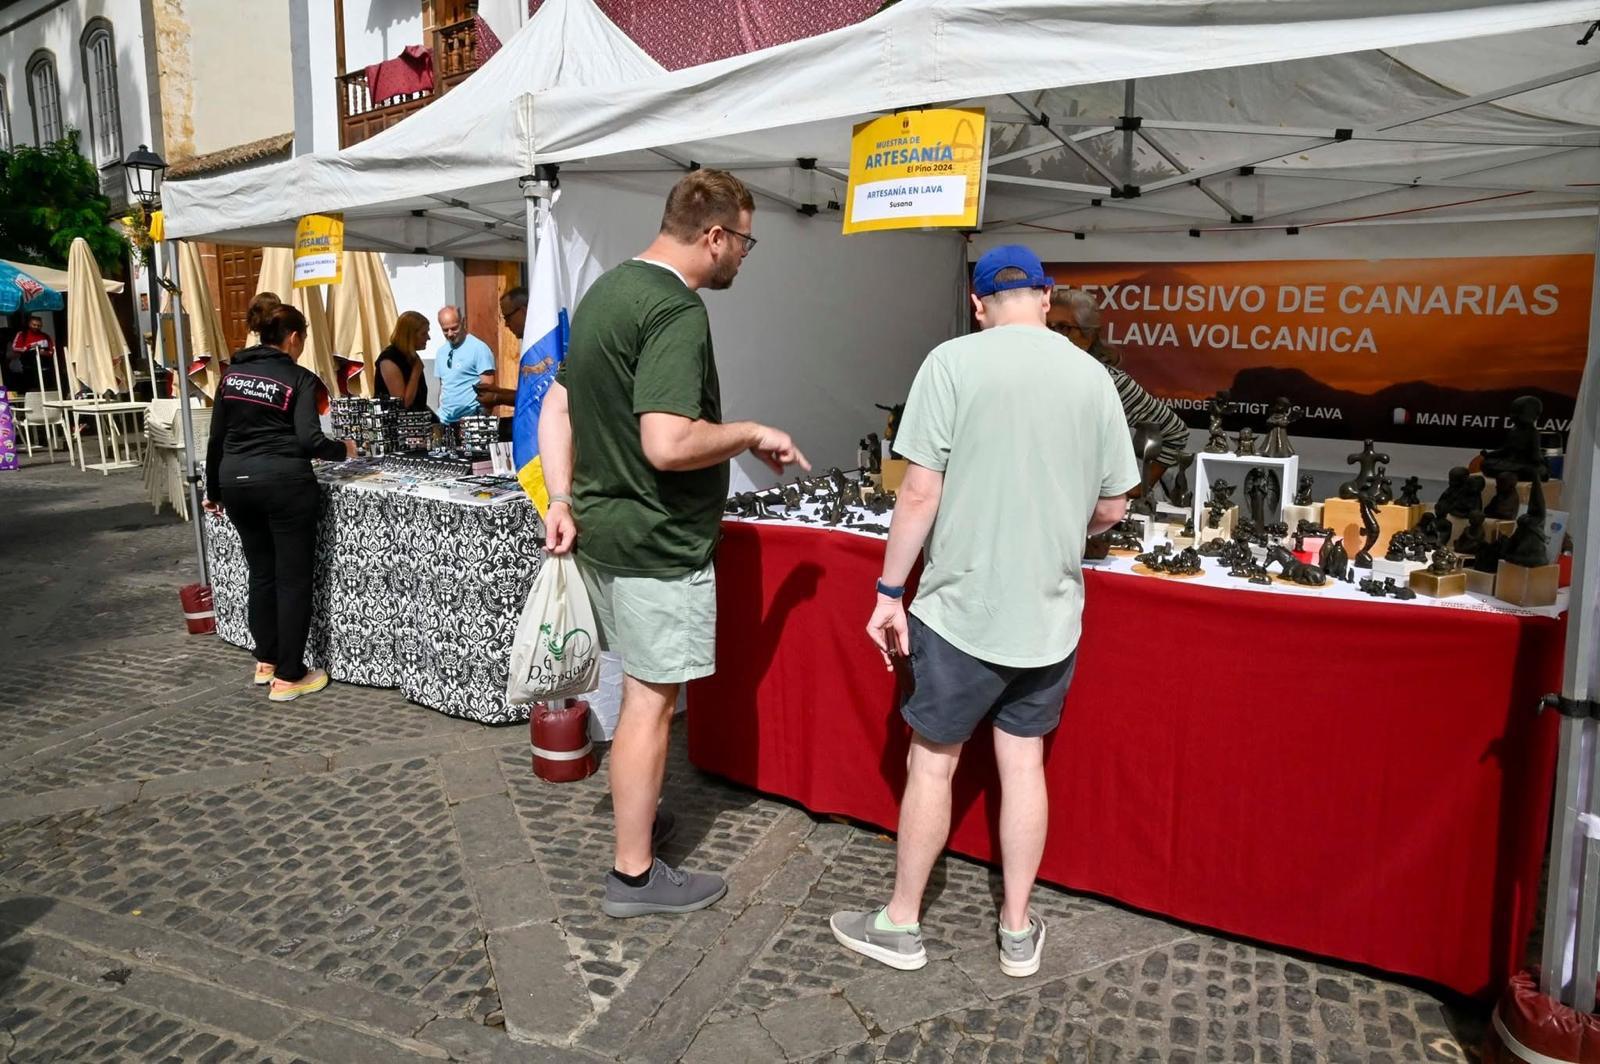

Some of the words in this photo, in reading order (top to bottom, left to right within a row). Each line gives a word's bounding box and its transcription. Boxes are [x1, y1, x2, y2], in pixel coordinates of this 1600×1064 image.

[876, 138, 908, 149] MUESTRA
[910, 136, 921, 144] DE
[865, 142, 953, 169] ARTESANÍA
[915, 165, 932, 173] Pino
[933, 164, 953, 172] 2024
[867, 185, 907, 200] ARTESANÍA
[908, 186, 919, 195] EN
[921, 185, 943, 195] LAVA
[1277, 285, 1327, 314] DE
[1338, 284, 1560, 316] CANARIAS
[1107, 322, 1180, 347] LAVA
[1187, 324, 1378, 353] VOLCANICA
[256, 381, 280, 394] Art
[1305, 406, 1342, 420] LAVA
[1416, 412, 1457, 426] MAIN
[1462, 415, 1500, 428] FAIT
